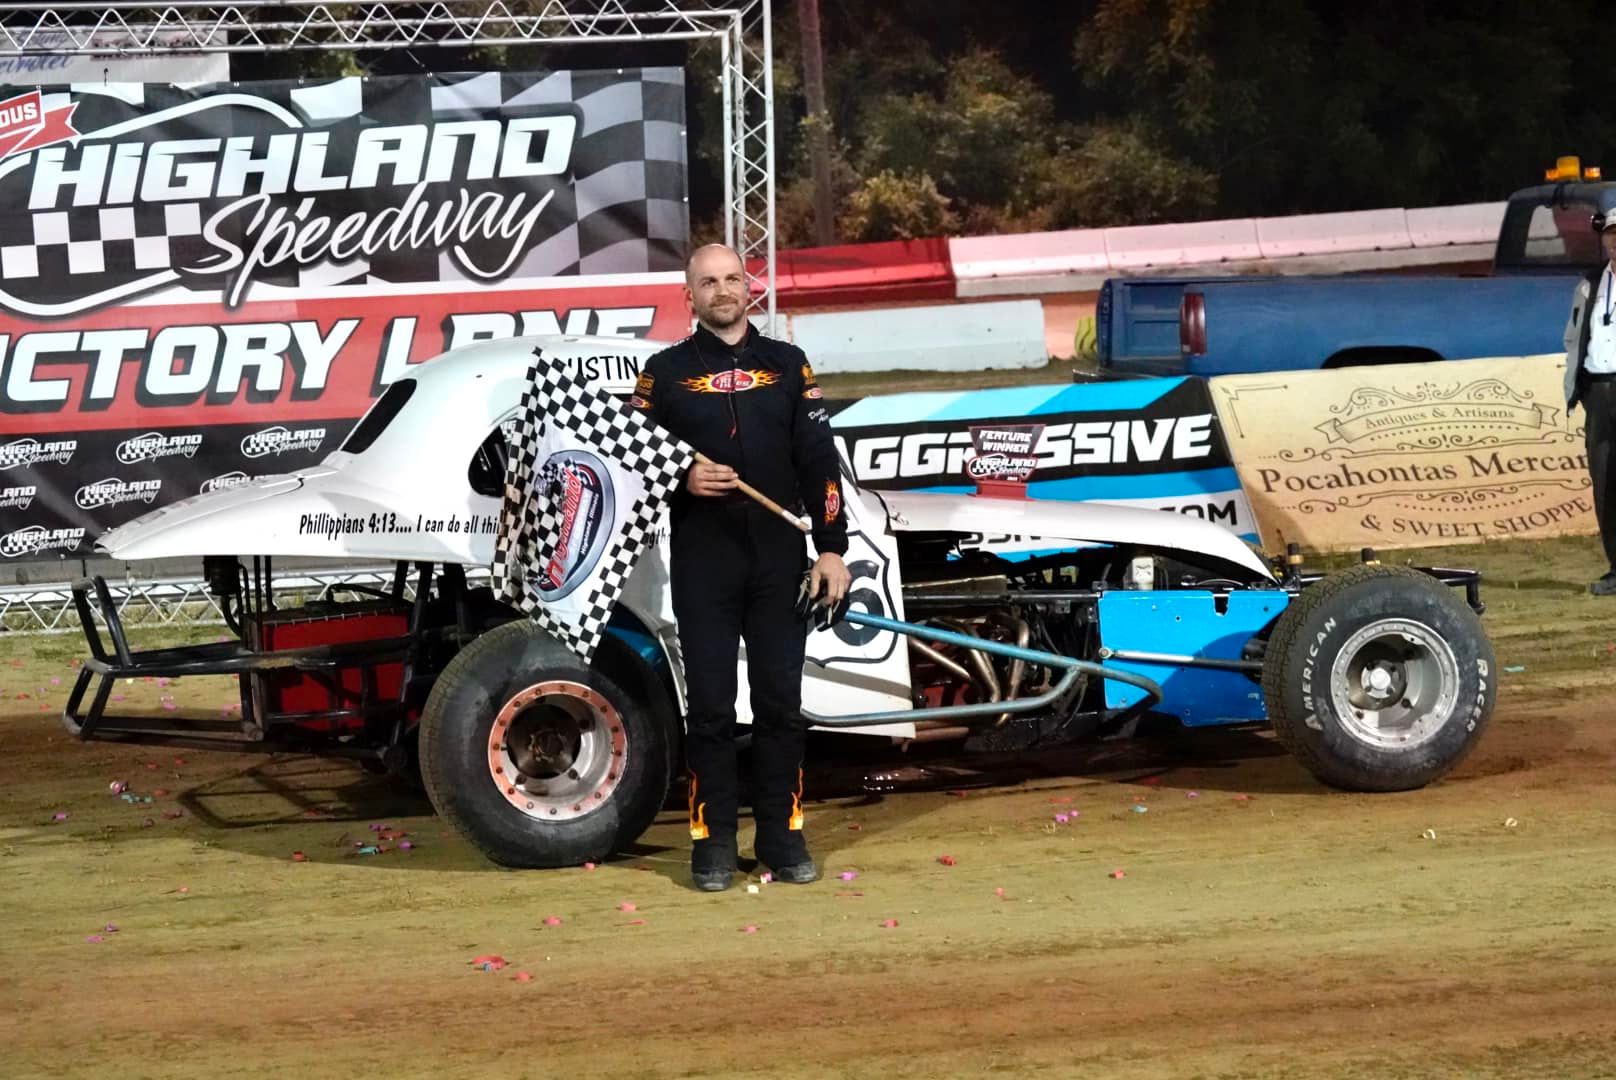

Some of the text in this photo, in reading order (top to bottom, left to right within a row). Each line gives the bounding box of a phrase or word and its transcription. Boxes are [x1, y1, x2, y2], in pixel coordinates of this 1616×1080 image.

[28, 114, 577, 210] HIGHLAND
[181, 180, 555, 306] Speedway
[1364, 405, 1516, 431] Antiques & Artisans
[125, 434, 203, 451] HIGHLAND
[249, 428, 326, 444] HIGHLAND
[979, 430, 1032, 443] FEATURE
[0, 440, 77, 456] HIGHLAND
[149, 445, 200, 463] Speedway
[272, 439, 323, 457] Speedway
[982, 441, 1030, 454] WINNER
[23, 451, 74, 469] Speedway
[1257, 459, 1458, 494] Pocahontas
[85, 480, 162, 496] HIGHLAND
[108, 489, 159, 508] Speedway
[416, 514, 422, 533] I
[425, 519, 443, 533] can
[447, 514, 460, 533] do
[464, 515, 477, 534] all
[1360, 496, 1593, 538] & SWEET SHOPPE
[8, 527, 86, 543] HIGHLAND
[31, 538, 82, 556] Speedway
[1302, 616, 1337, 731] AMERICAN
[1466, 658, 1489, 733] RACER
